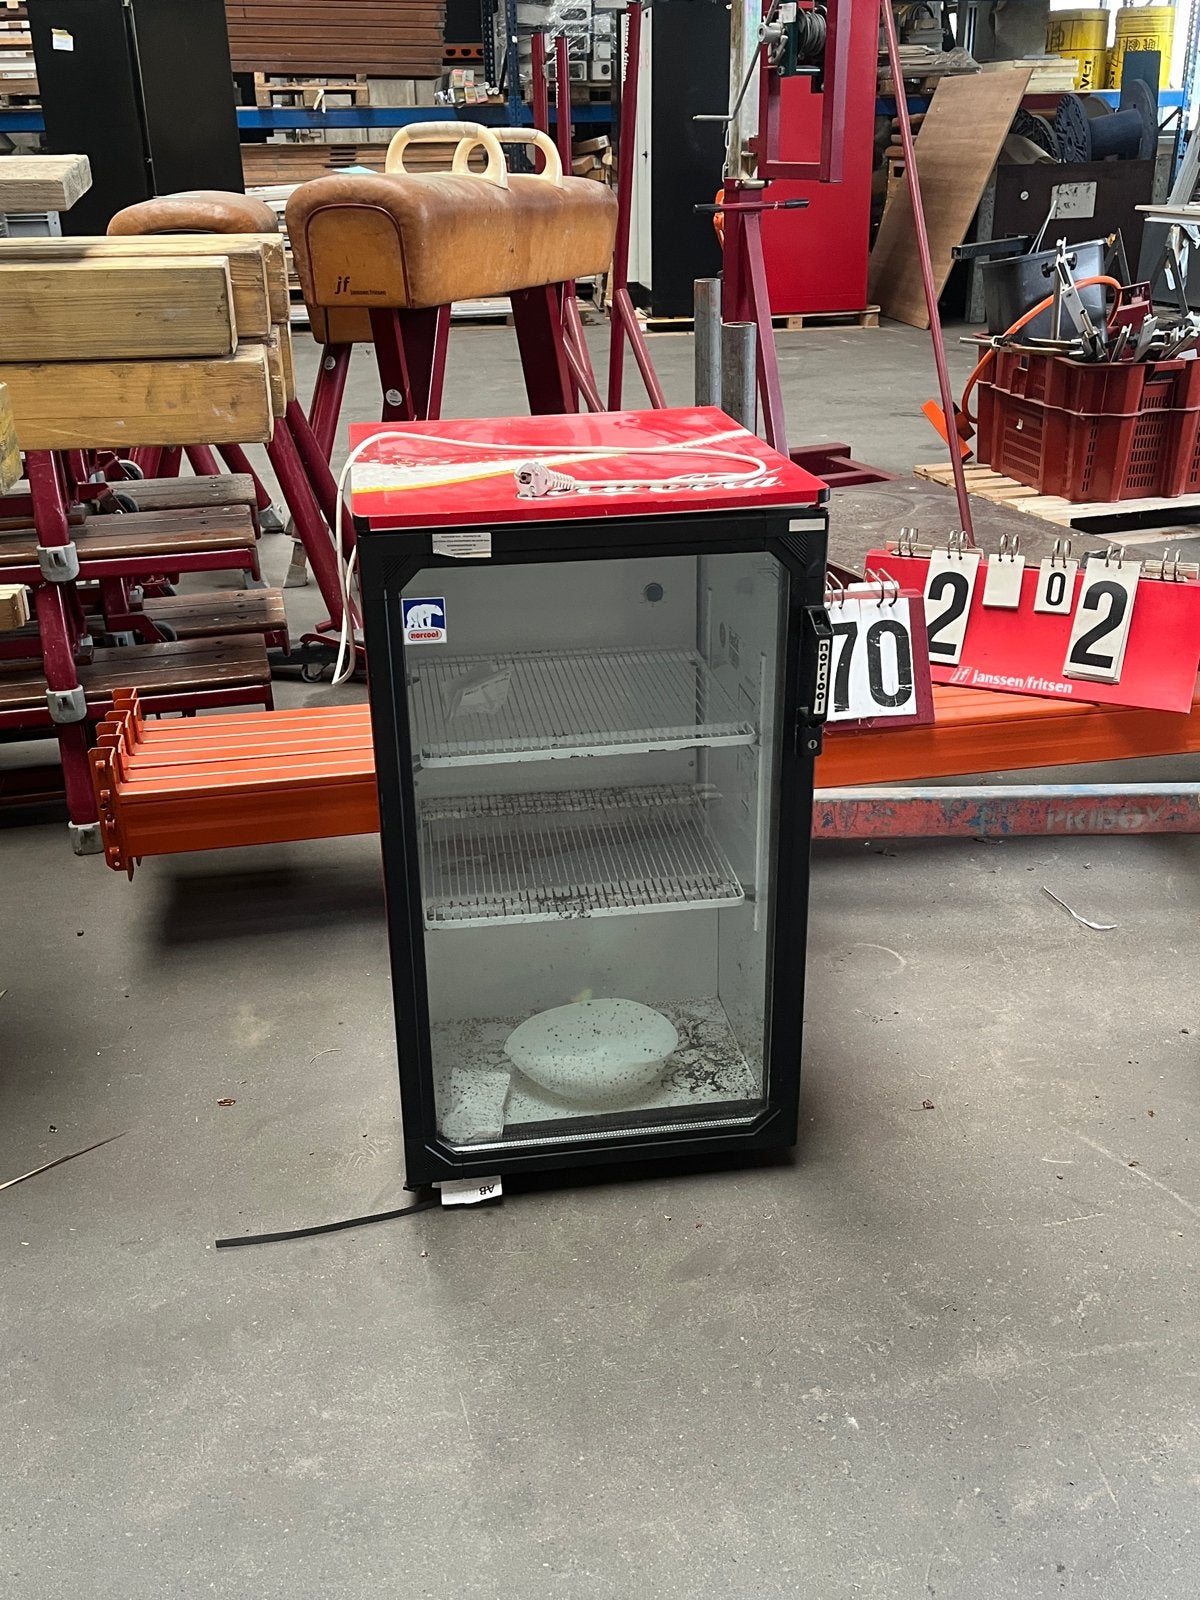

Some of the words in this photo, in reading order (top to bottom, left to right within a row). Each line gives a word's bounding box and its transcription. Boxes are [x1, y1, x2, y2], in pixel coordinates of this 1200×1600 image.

[334, 276, 351, 295] jf
[410, 630, 439, 639] norcool
[1069, 580, 1128, 669] 2
[816, 642, 829, 712] norcool
